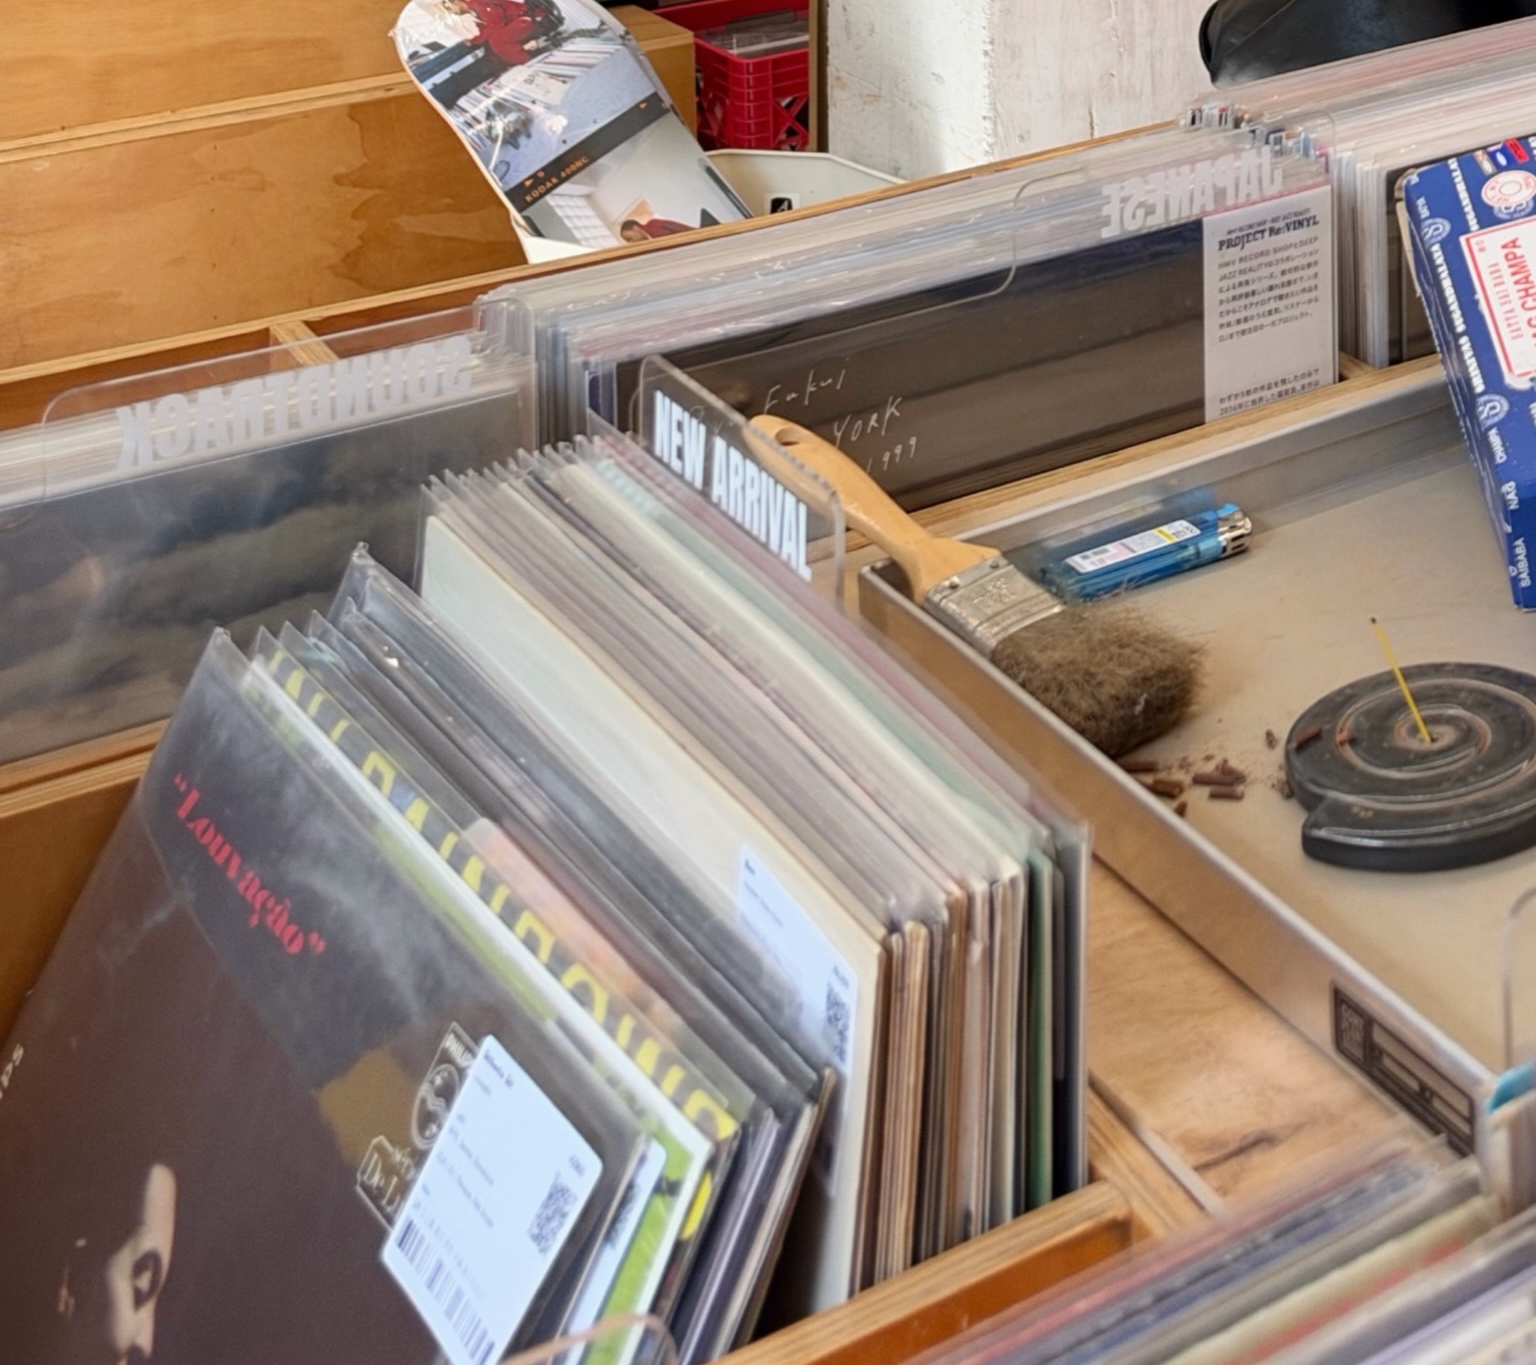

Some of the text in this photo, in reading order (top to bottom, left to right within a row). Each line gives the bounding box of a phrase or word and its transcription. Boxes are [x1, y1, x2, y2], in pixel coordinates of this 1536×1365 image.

[524, 176, 559, 202] KODAK
[1218, 215, 1319, 251] PROJECT Re:VINYL
[1239, 248, 1271, 264] RECORD
[1218, 270, 1237, 282] JAZZ
[833, 396, 903, 449] YORK
[867, 436, 917, 474] 1999
[654, 389, 812, 583] NEW ARRIVAL
[1512, 536, 1531, 587] SAIBABA
